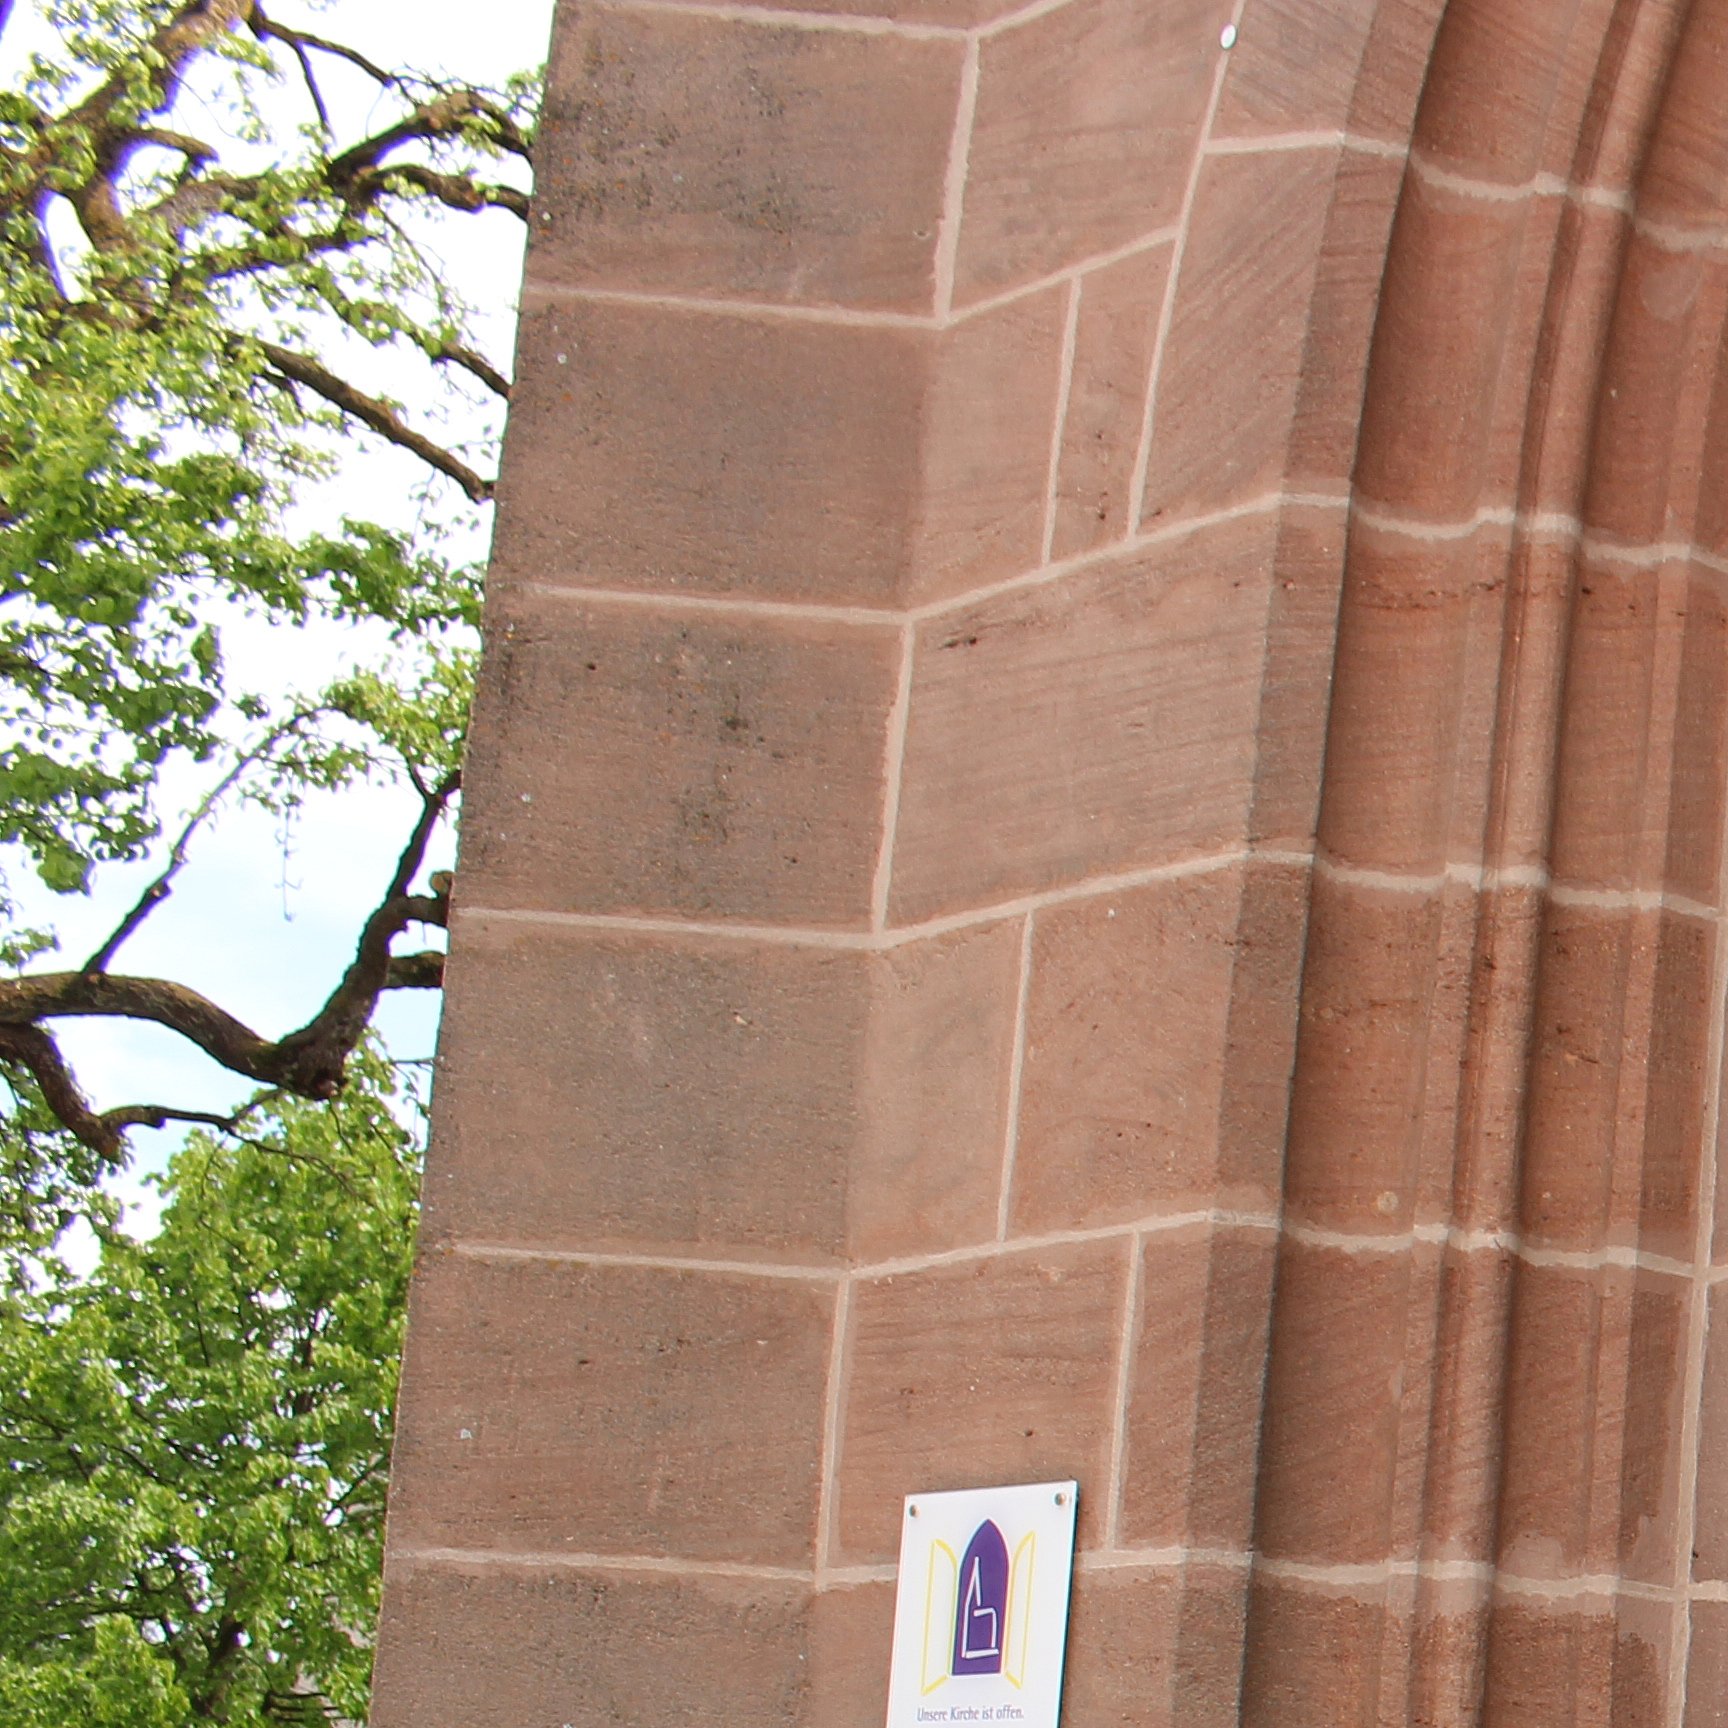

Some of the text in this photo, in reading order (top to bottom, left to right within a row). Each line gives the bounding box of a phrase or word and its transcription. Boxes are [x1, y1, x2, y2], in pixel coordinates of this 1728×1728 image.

[917, 1704, 1024, 1722] Unsere Kirche ist offen.
